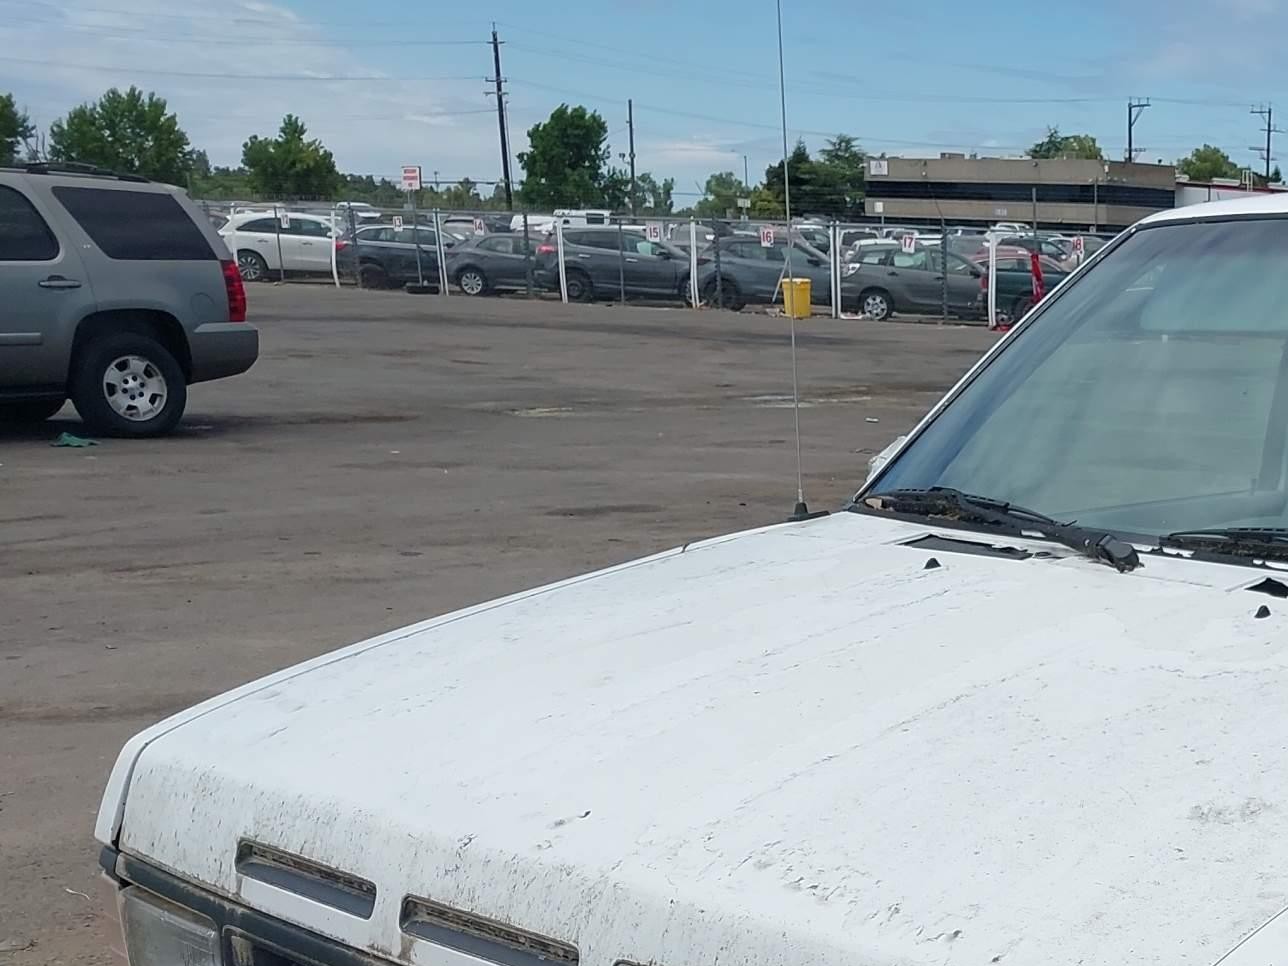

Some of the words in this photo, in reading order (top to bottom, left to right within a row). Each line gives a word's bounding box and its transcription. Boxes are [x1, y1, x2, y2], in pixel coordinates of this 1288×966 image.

[649, 227, 659, 239] 15
[762, 231, 772, 243] 16
[903, 236, 913, 249] 17
